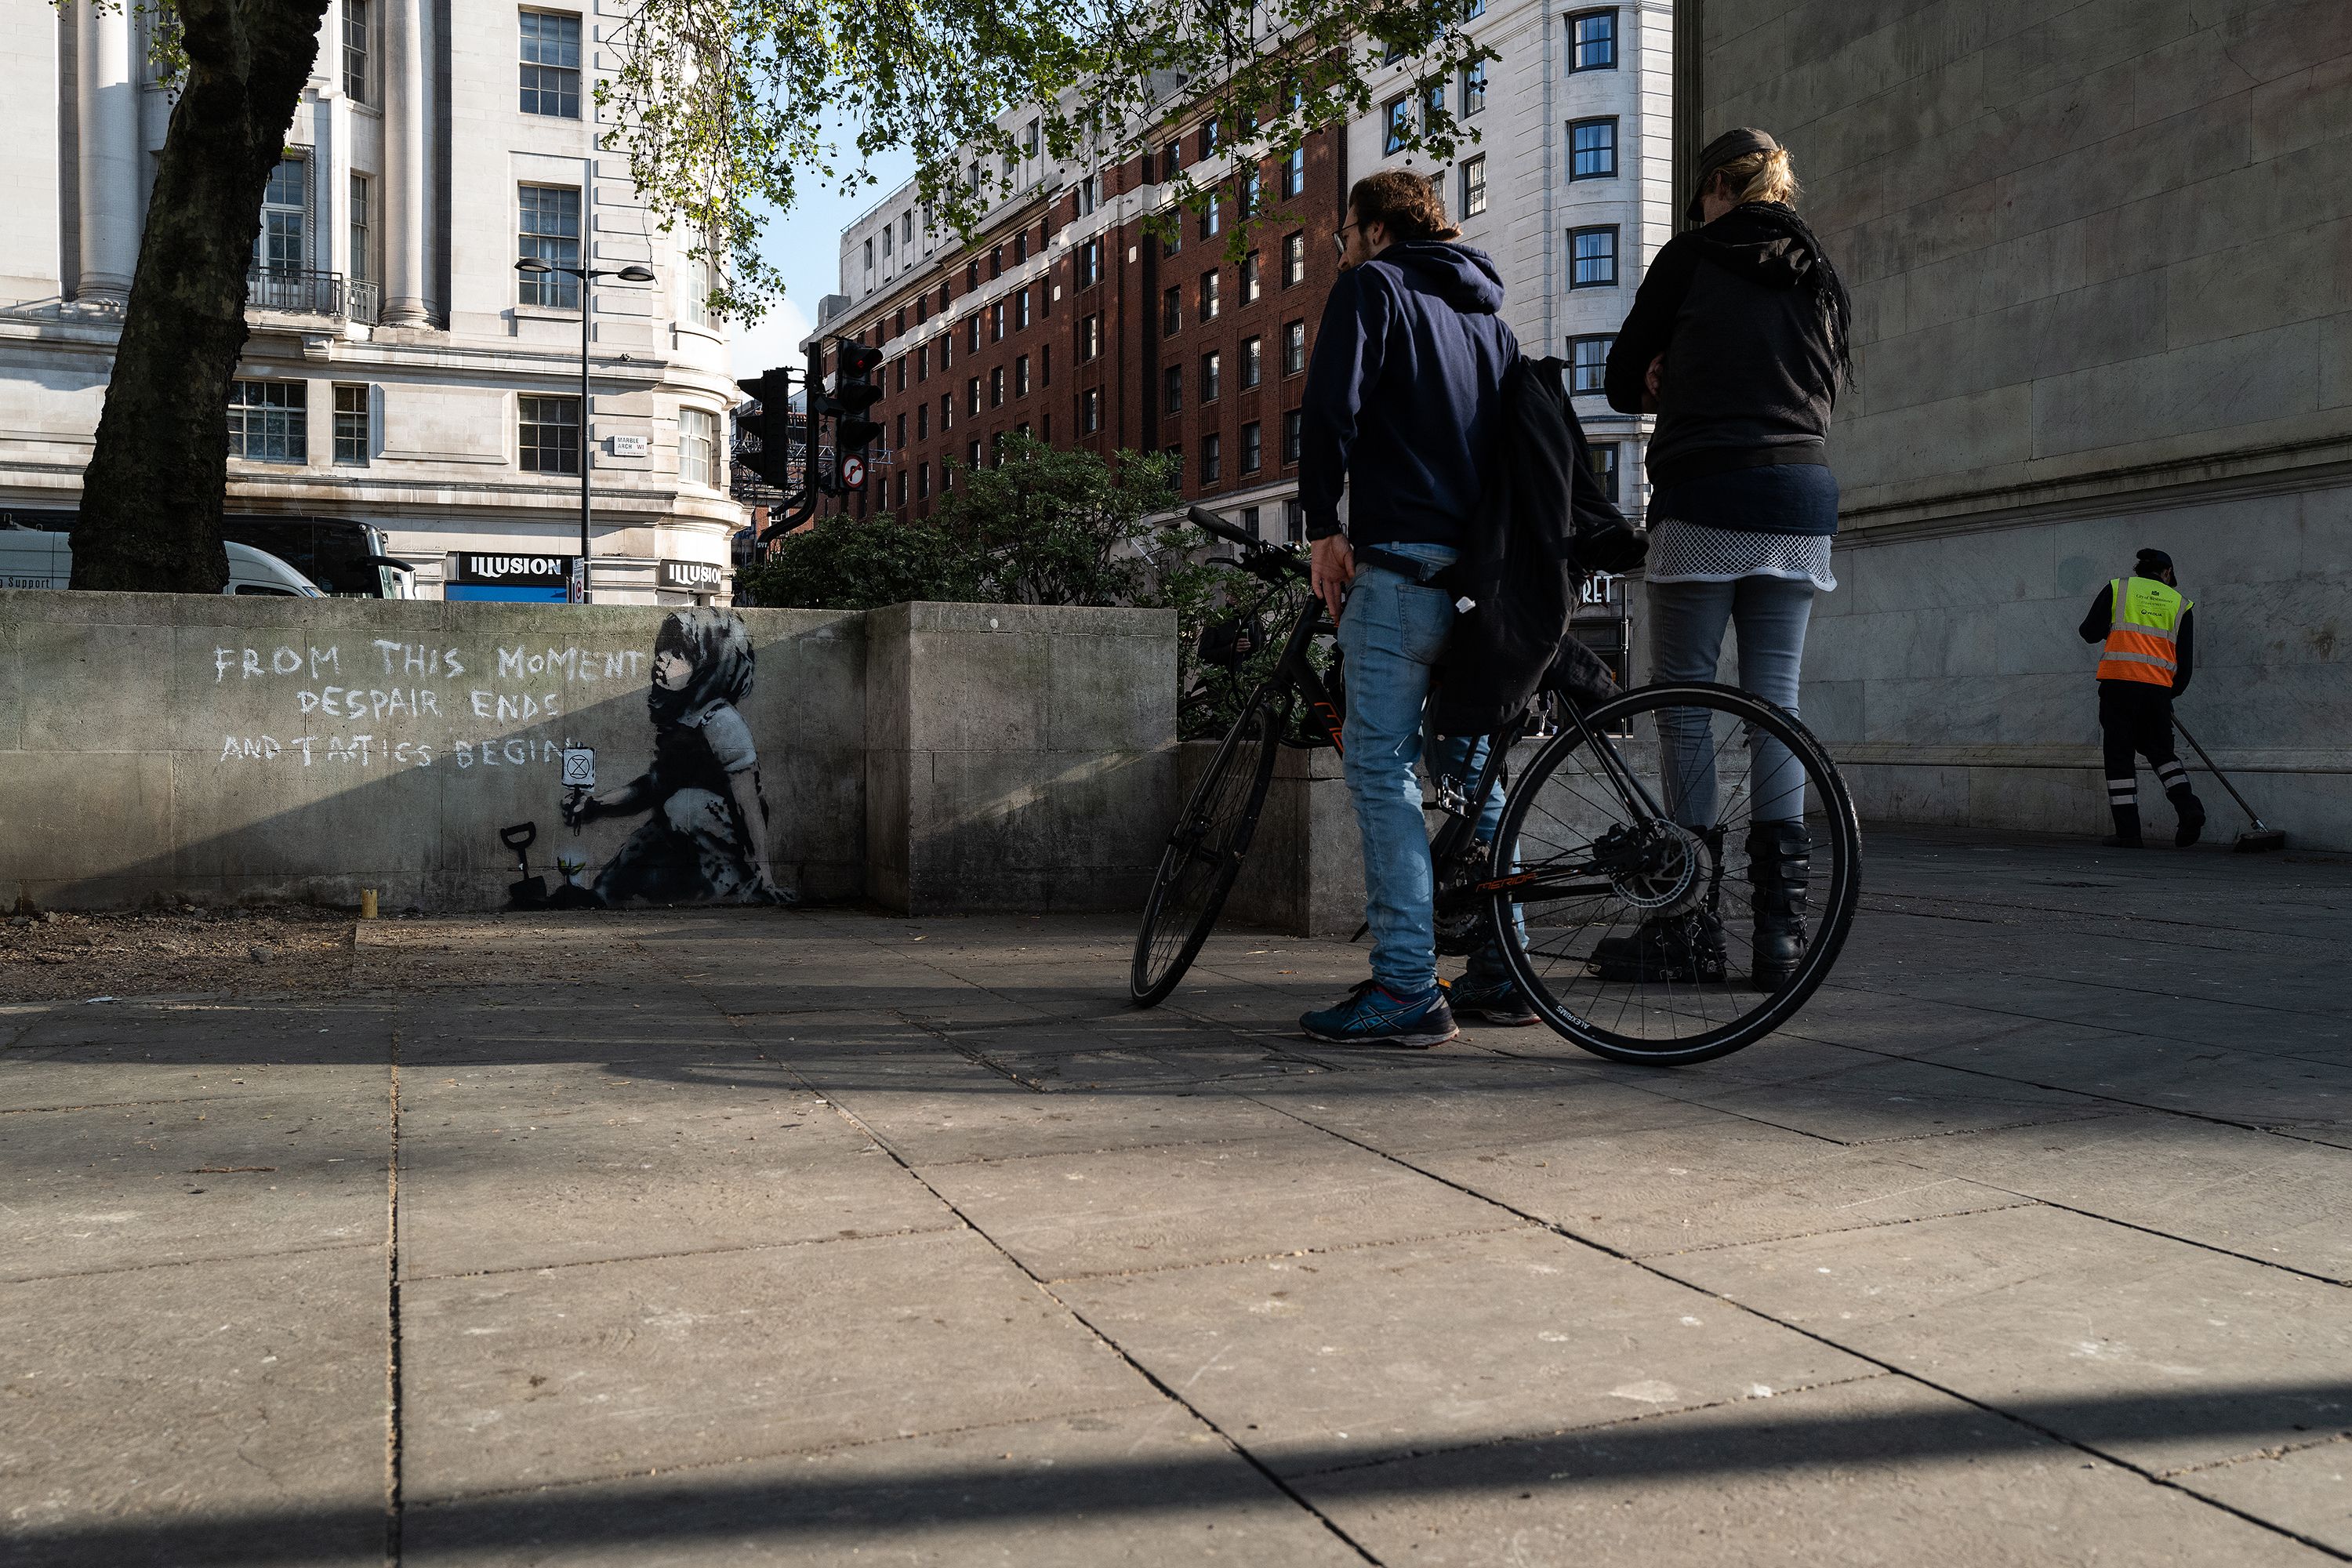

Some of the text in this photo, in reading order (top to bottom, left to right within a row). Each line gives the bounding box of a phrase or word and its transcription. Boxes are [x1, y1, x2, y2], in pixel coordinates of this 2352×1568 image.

[470, 556, 561, 578] ILLUSION
[8, 576, 49, 590] Support
[1582, 575, 1613, 603] RET
[213, 639, 645, 682] FROM THIS MOMENT
[296, 685, 558, 722] DESPAIR ENDS
[220, 735, 281, 762] AND
[1475, 872, 1538, 893] MERIDA
[1555, 1005, 1591, 1029] ALEXRIMS
